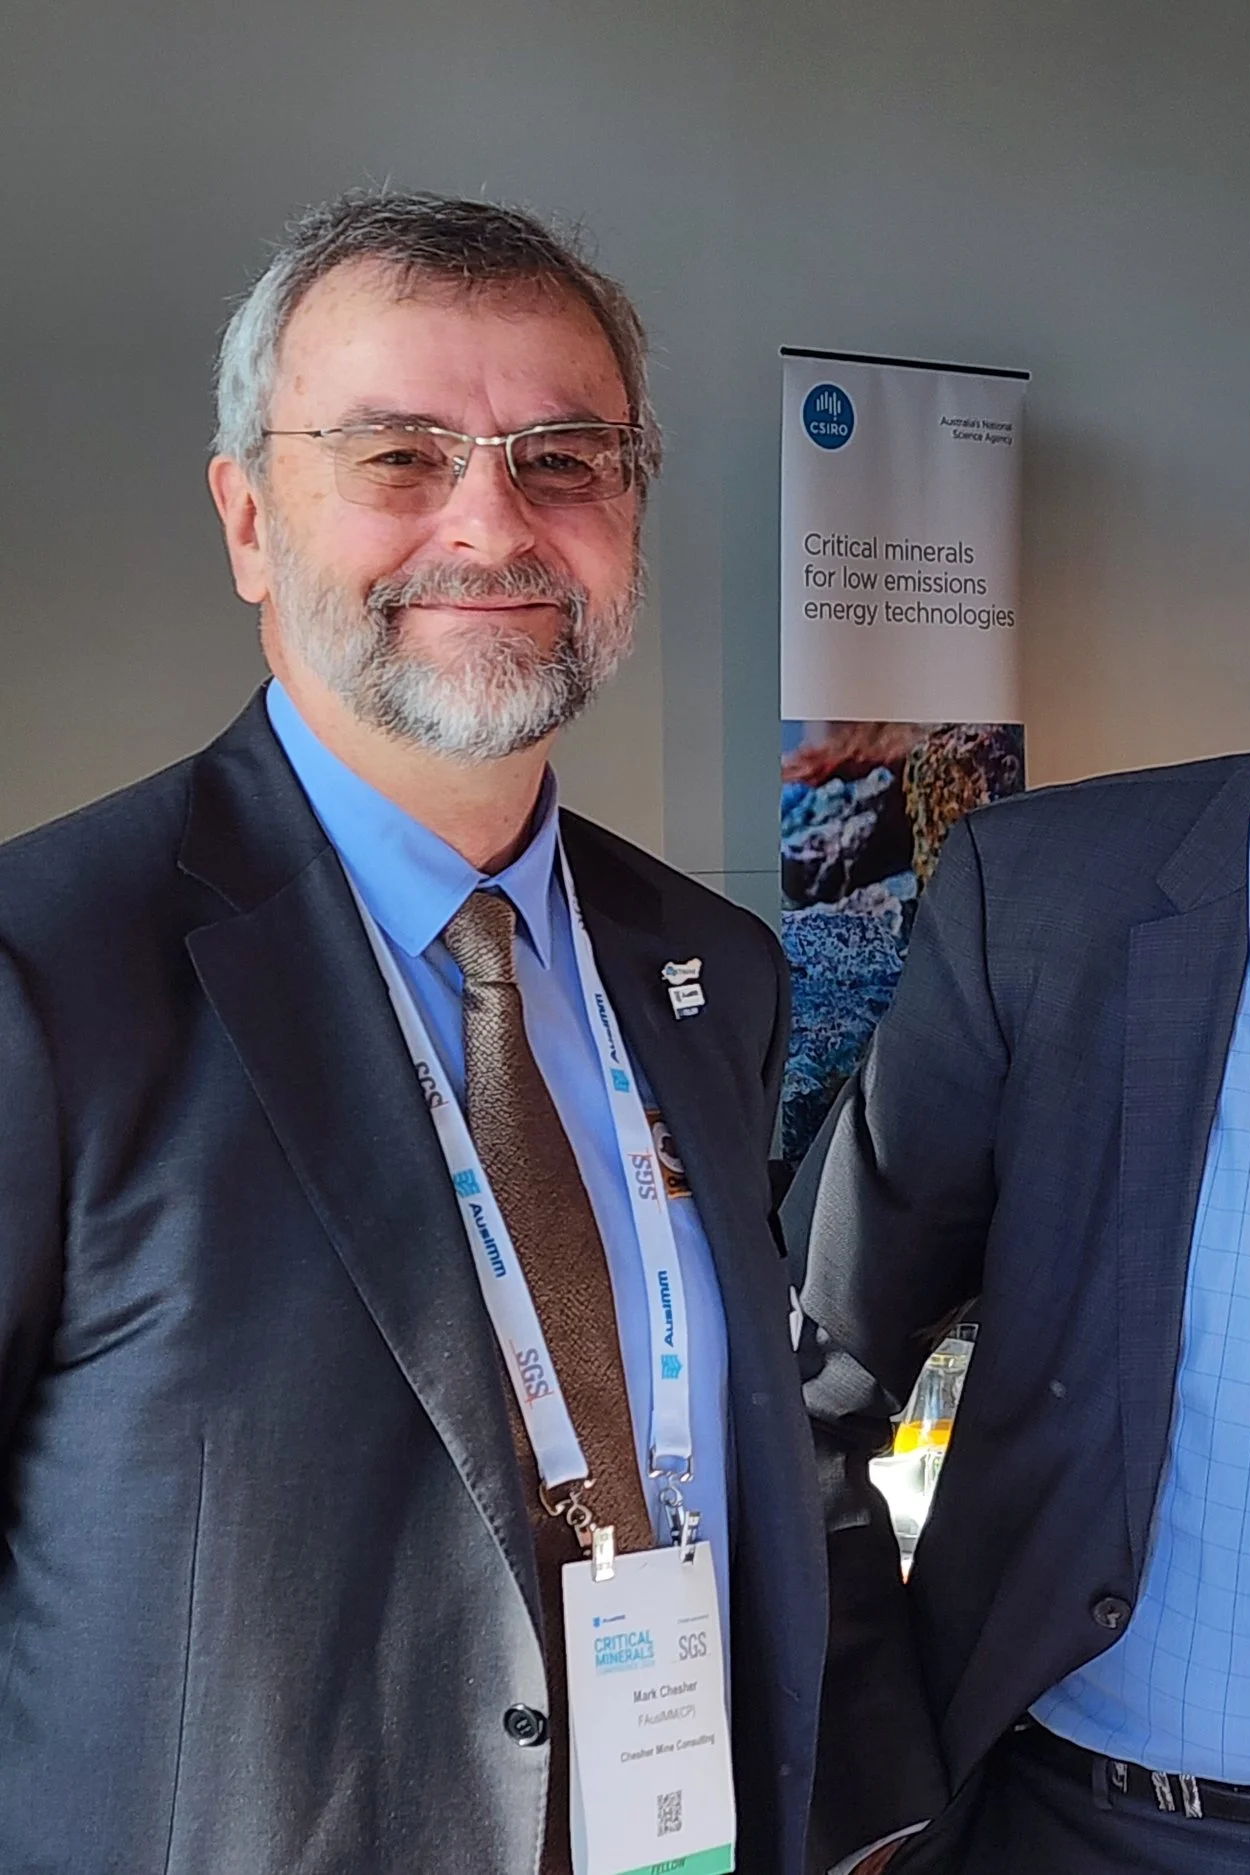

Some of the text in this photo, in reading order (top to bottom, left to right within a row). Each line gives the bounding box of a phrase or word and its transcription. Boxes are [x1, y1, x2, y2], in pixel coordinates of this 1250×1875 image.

[809, 420, 849, 436] CSIRO
[804, 532, 975, 564] Critical minerals
[804, 564, 987, 595] for low emissions
[804, 601, 1015, 630] energy technologies
[631, 1154, 658, 1200] SGS
[516, 1348, 551, 1399] SGS
[594, 1629, 653, 1653] CRITICAL
[678, 1631, 707, 1661] SGS
[595, 1644, 655, 1668] MINERALS
[633, 1680, 698, 1703] Mark Chesher
